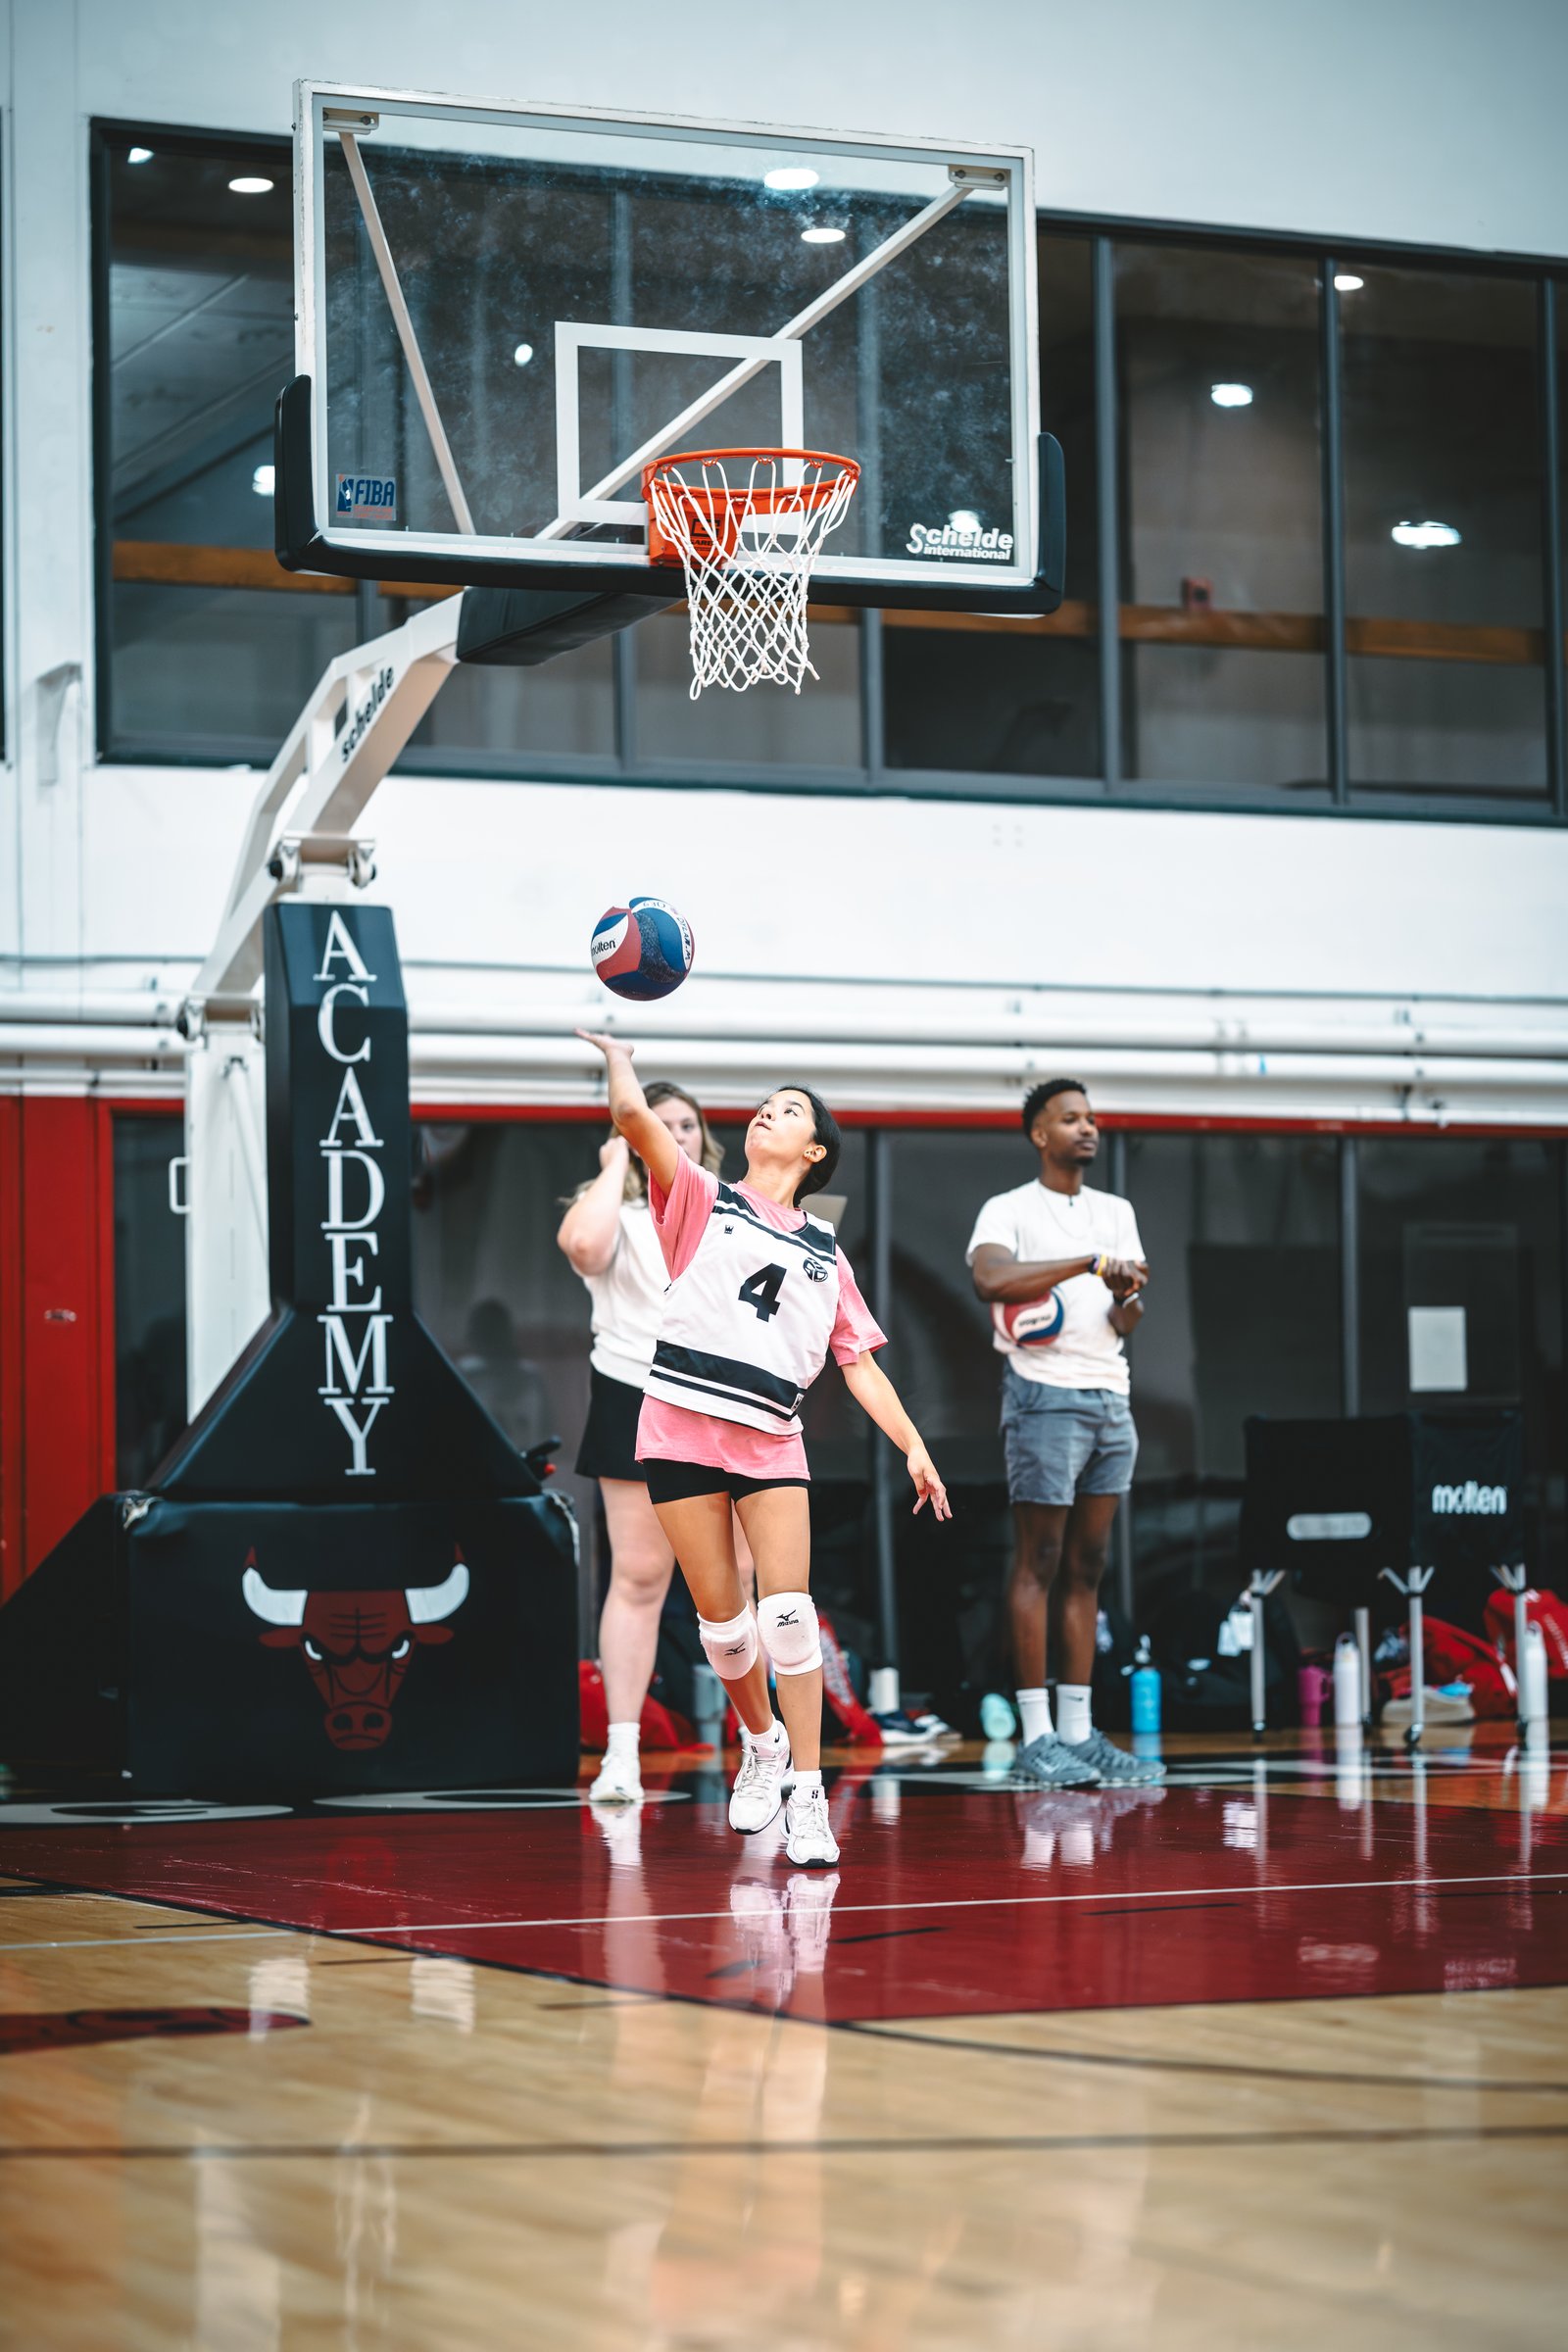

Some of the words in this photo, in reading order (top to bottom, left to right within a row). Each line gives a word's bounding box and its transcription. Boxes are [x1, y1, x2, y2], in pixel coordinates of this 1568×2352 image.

[355, 479, 395, 507] FIBA
[906, 522, 1013, 554] Schelde
[923, 544, 1011, 561] international
[341, 666, 394, 762] schelde
[312, 909, 394, 1475] ACADEMY
[738, 1262, 787, 1323] 4
[1432, 1480, 1507, 1515] molten
